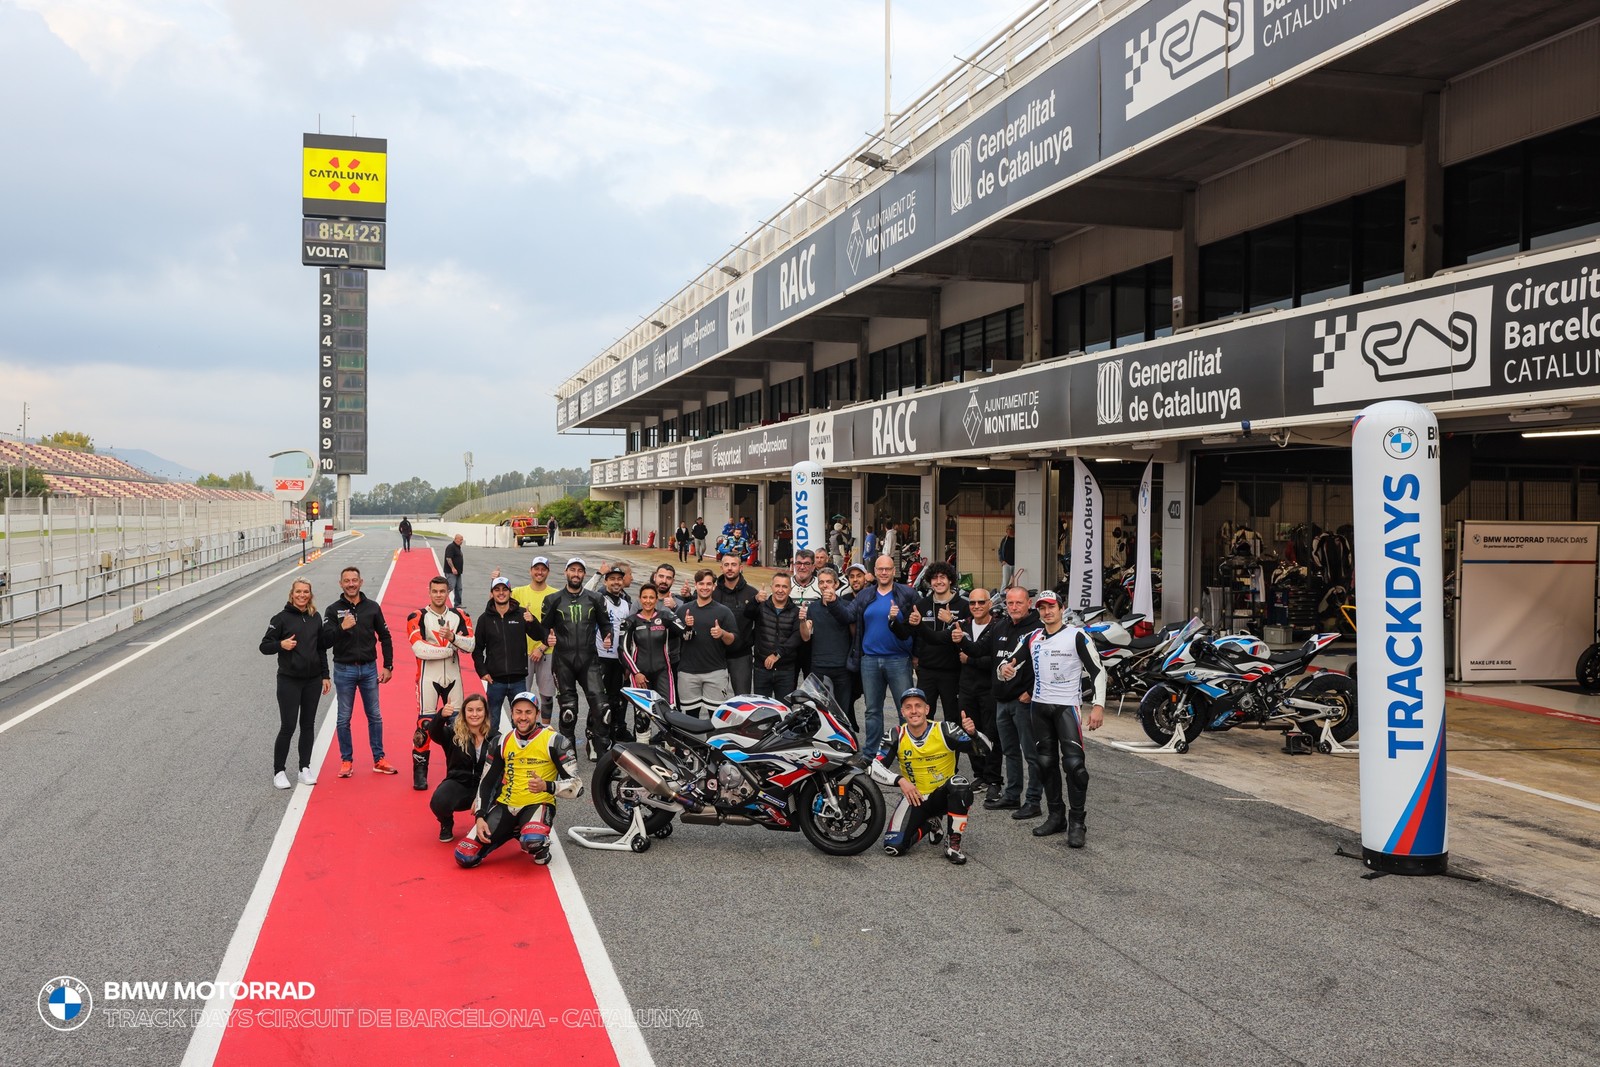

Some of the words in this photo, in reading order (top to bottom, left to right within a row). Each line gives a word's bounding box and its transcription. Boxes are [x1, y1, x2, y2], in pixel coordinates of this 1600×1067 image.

[977, 89, 1056, 163] Generalitat
[977, 170, 995, 200] de
[998, 125, 1073, 187] Catalunya
[309, 169, 379, 182] CATALUNYA
[866, 196, 906, 233] AJUNTAMENT
[906, 189, 916, 207] DE
[319, 223, 381, 243] 8:54:23
[866, 208, 916, 258] MONTMELÓ
[306, 245, 349, 259] VOLTA
[322, 274, 332, 286] 1
[780, 243, 816, 311] RACC
[1506, 266, 1600, 313] Circuit
[322, 294, 332, 306] 2
[322, 315, 332, 327] 3
[322, 336, 332, 348] 4
[322, 356, 332, 368] 5
[1129, 347, 1223, 388] Generalitat
[322, 376, 332, 388] 6
[322, 397, 332, 409] 7
[984, 396, 1027, 413] AJUNTAMENT
[1029, 390, 1039, 405] DE
[1129, 395, 1149, 422] de
[1152, 387, 1241, 419] Catalunya
[322, 418, 332, 430] 8
[984, 406, 1039, 434] MONTMELÓ
[872, 400, 918, 456] RACC
[1387, 427, 1415, 438] BMW
[322, 438, 332, 450] 9
[321, 458, 333, 470] 10
[1170, 503, 1180, 517] 40
[1503, 536, 1544, 544] MOTORRAD
[1383, 473, 1424, 759] TRACKDAYS
